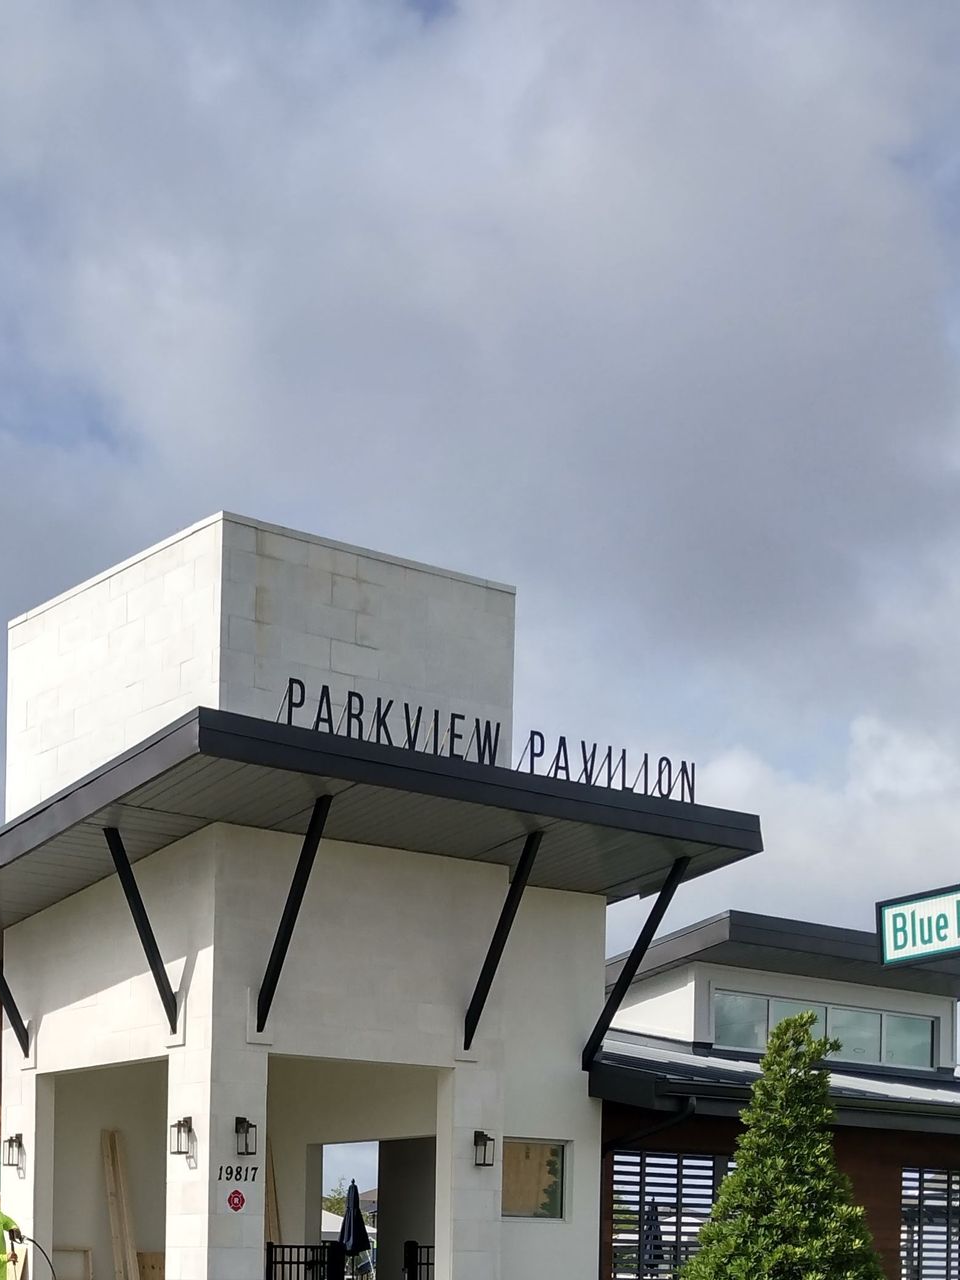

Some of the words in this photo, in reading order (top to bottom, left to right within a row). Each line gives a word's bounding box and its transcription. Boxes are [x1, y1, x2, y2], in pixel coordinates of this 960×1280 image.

[287, 677, 501, 767] PARKVIEW
[528, 730, 697, 804] PAVILION
[892, 910, 949, 951] Blue
[218, 1165, 259, 1182] 19817
